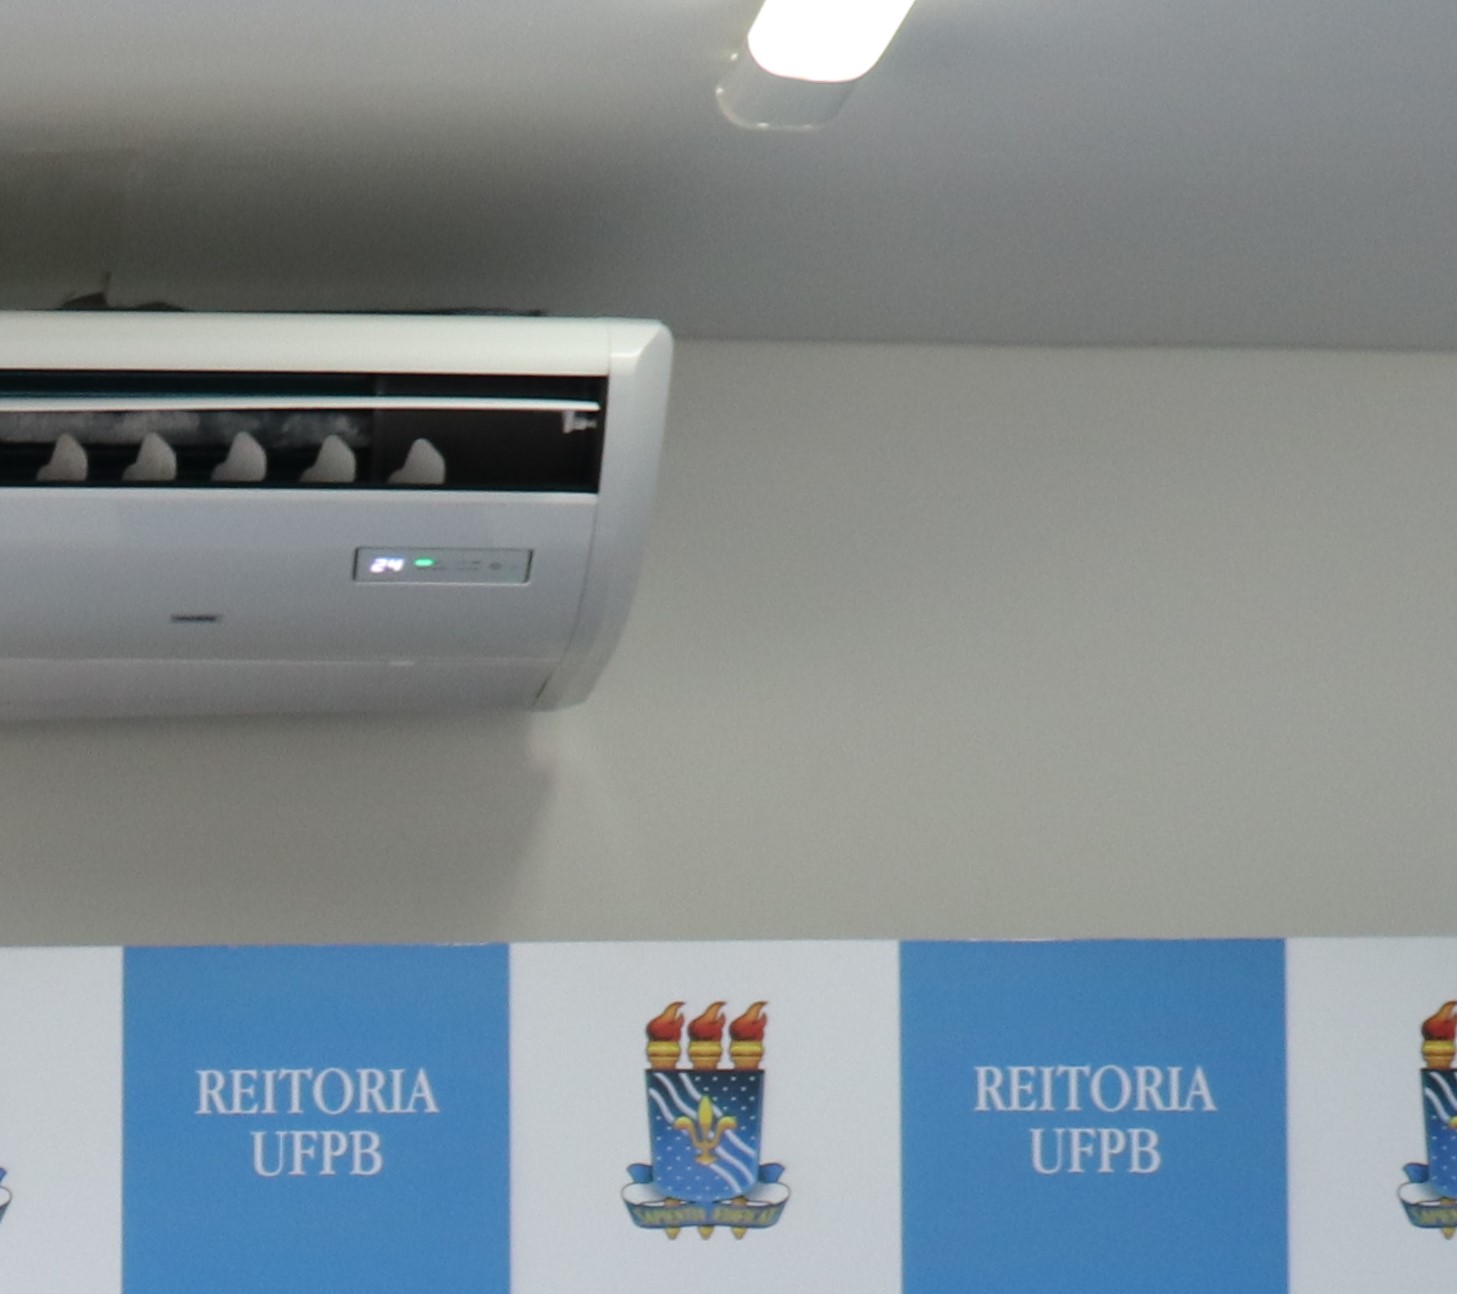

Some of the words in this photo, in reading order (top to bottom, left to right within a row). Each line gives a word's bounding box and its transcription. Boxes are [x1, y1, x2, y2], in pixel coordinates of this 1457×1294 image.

[369, 556, 406, 574] 24
[195, 1067, 439, 1116] REITORIA
[974, 1064, 1217, 1113] REITORIA
[251, 1130, 384, 1177] UFPB
[1029, 1127, 1162, 1175] UFPB
